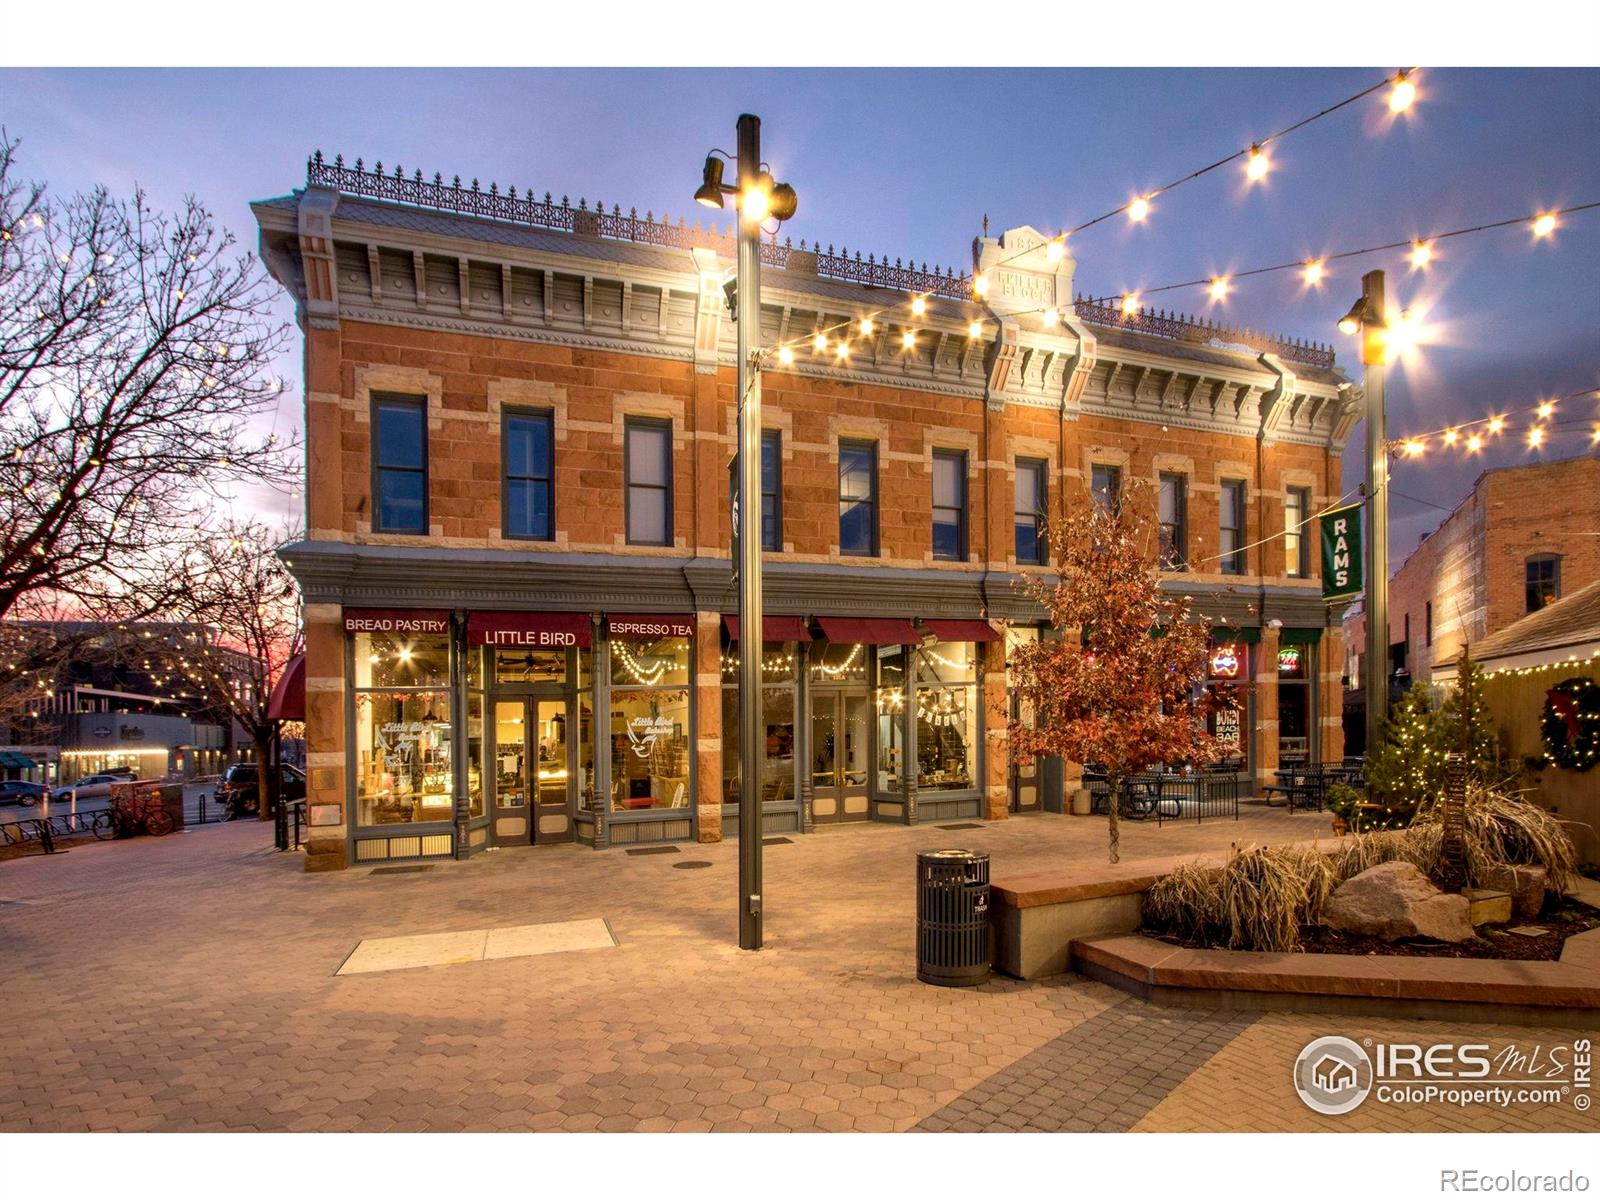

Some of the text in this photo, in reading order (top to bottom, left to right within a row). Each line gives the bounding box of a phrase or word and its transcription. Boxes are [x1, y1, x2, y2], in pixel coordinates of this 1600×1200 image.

[1333, 518, 1349, 588] RAMS
[345, 619, 446, 631] BREAD PASTRY
[610, 622, 693, 636] ESPRESSO TEA
[485, 631, 576, 646] LITTLE BIRD
[631, 717, 653, 726] Little
[1216, 725, 1240, 733] BEACH
[974, 904, 988, 912] TRASH
